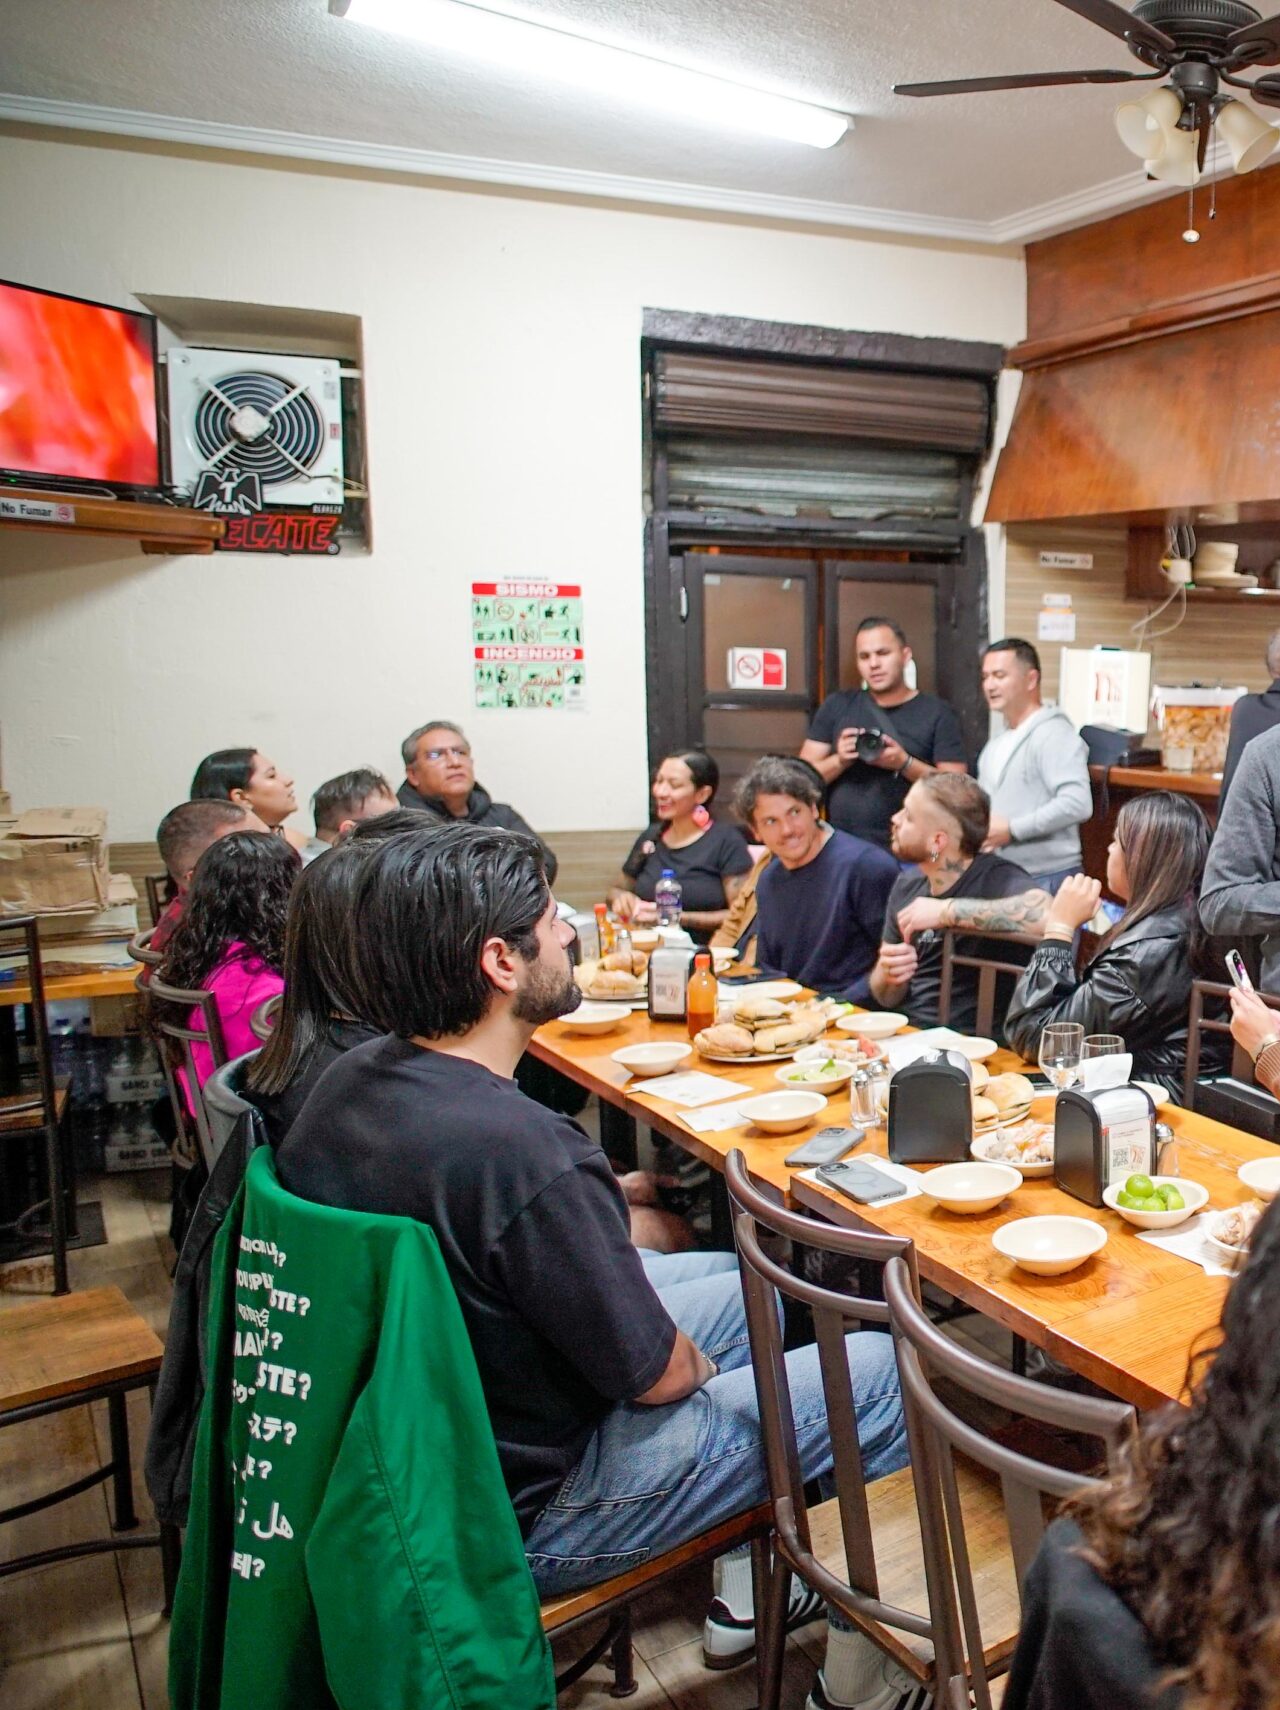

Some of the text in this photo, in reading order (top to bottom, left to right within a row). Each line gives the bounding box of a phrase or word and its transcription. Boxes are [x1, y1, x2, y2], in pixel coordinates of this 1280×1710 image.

[1, 502, 52, 516] No Fumar
[219, 514, 338, 551] ECATE
[495, 584, 559, 597] SISMO
[483, 647, 576, 660] INCENDIO
